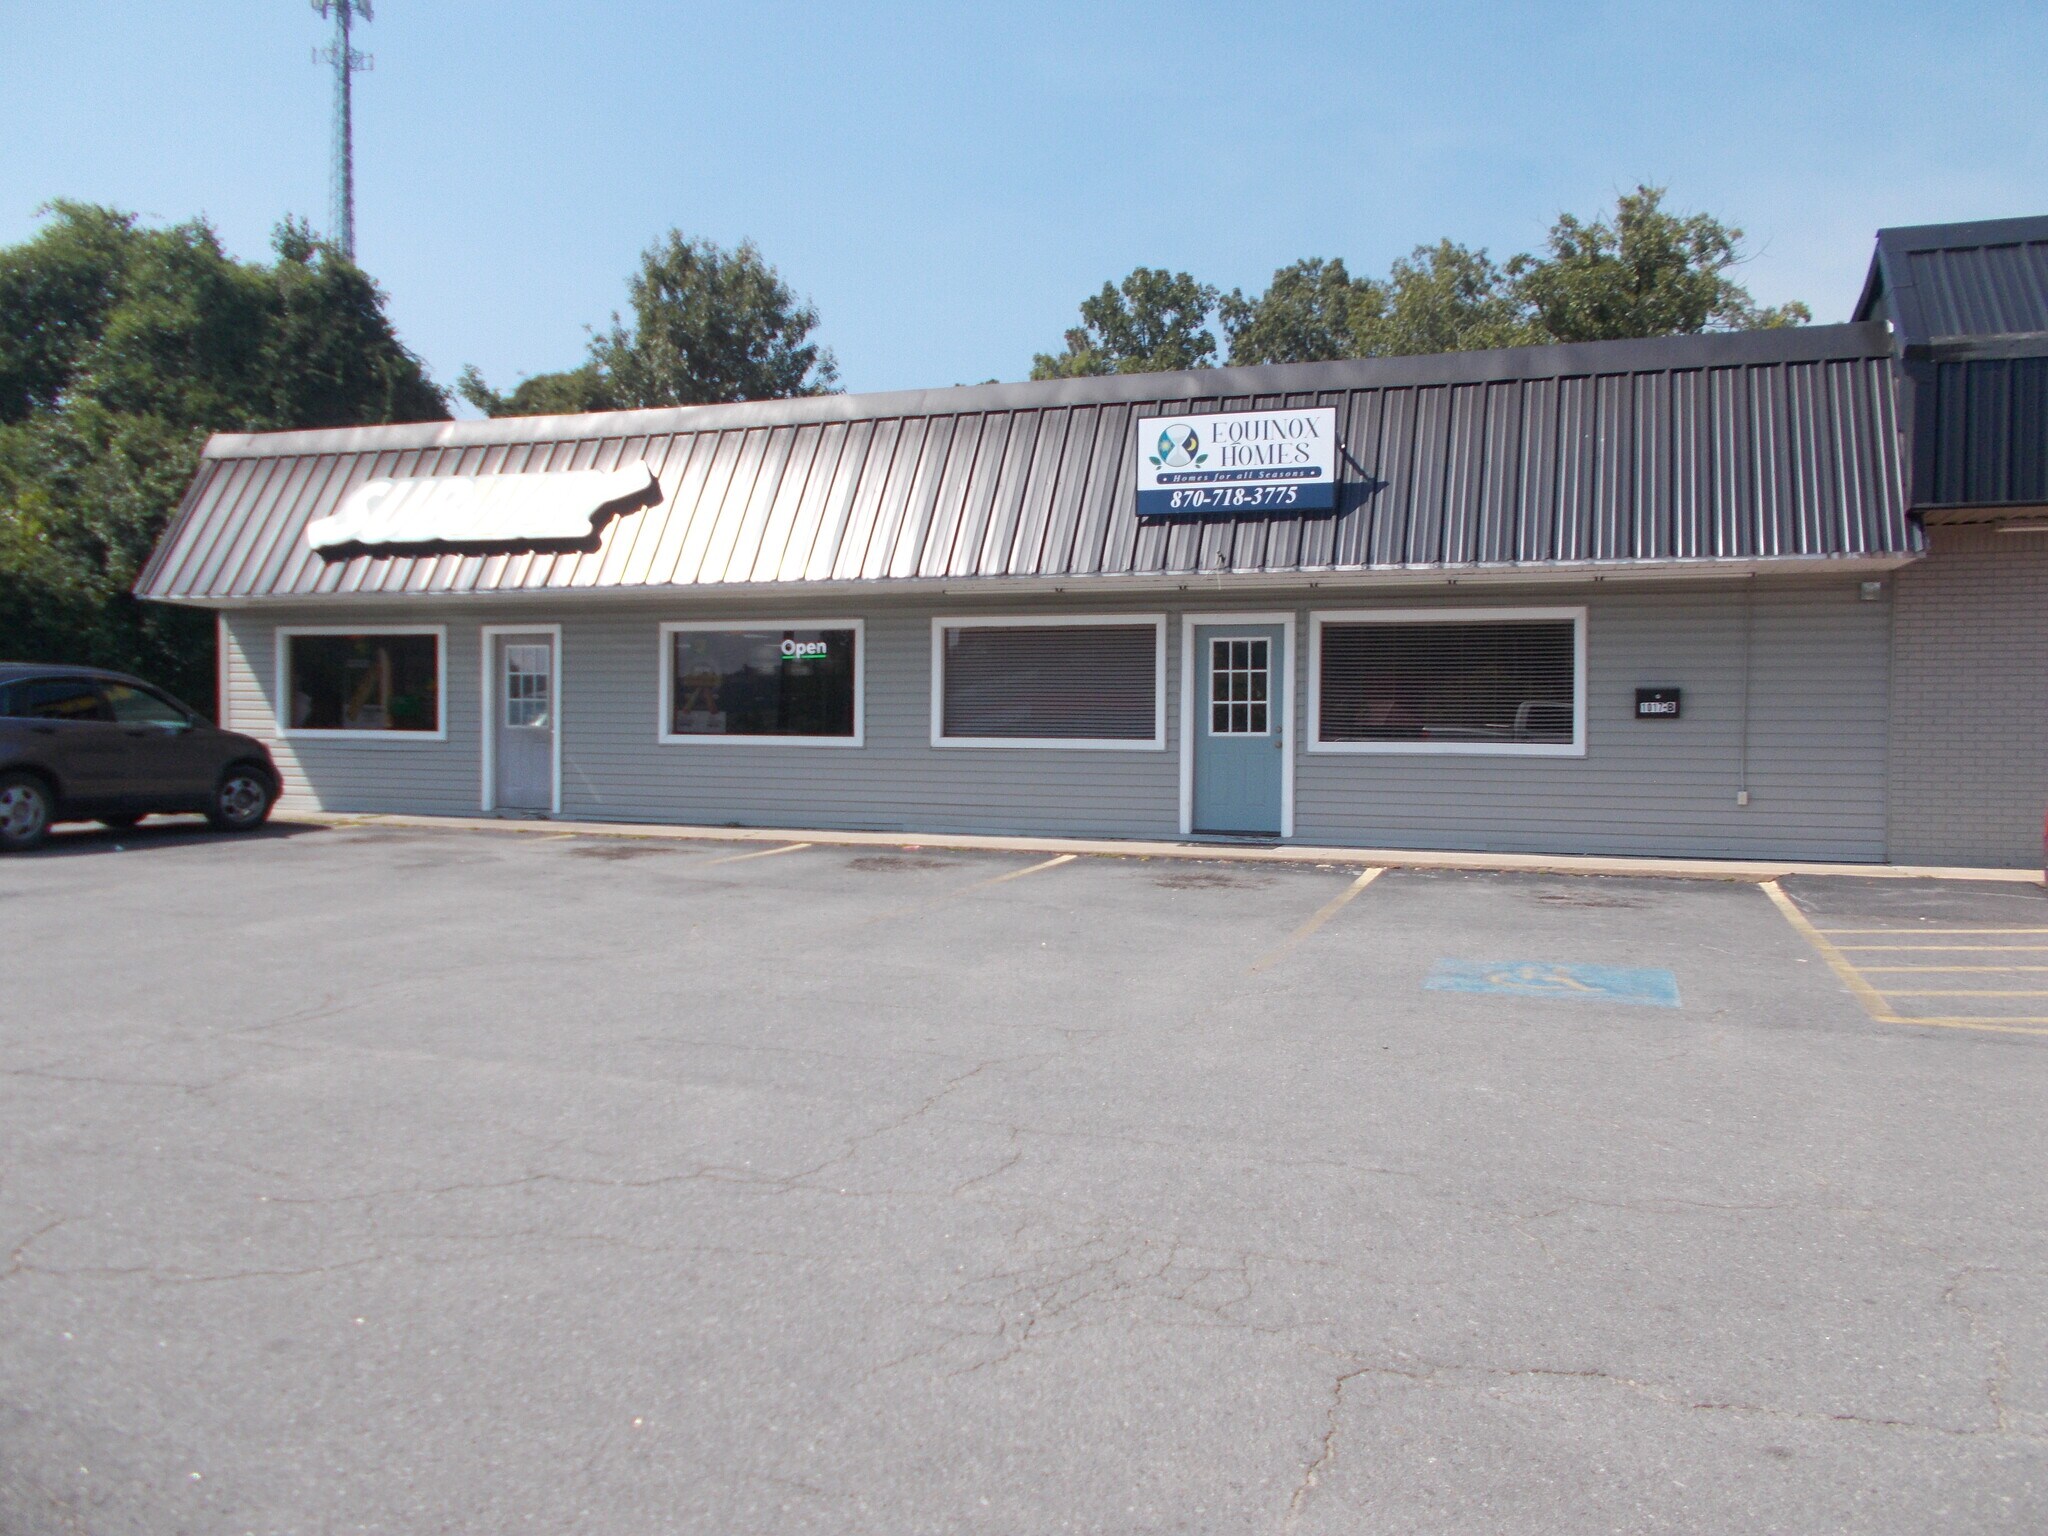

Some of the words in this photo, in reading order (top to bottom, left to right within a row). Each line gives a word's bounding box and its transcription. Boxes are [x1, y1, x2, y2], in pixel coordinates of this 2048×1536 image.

[1212, 416, 1321, 446] EQUINOX
[1221, 442, 1310, 467] HOMES
[1173, 474, 1209, 483] Homes
[1213, 472, 1231, 483] for
[1236, 471, 1253, 480] all
[1259, 469, 1305, 479] Seasons
[1170, 486, 1298, 508] 870-718-3775
[781, 639, 827, 658] Open
